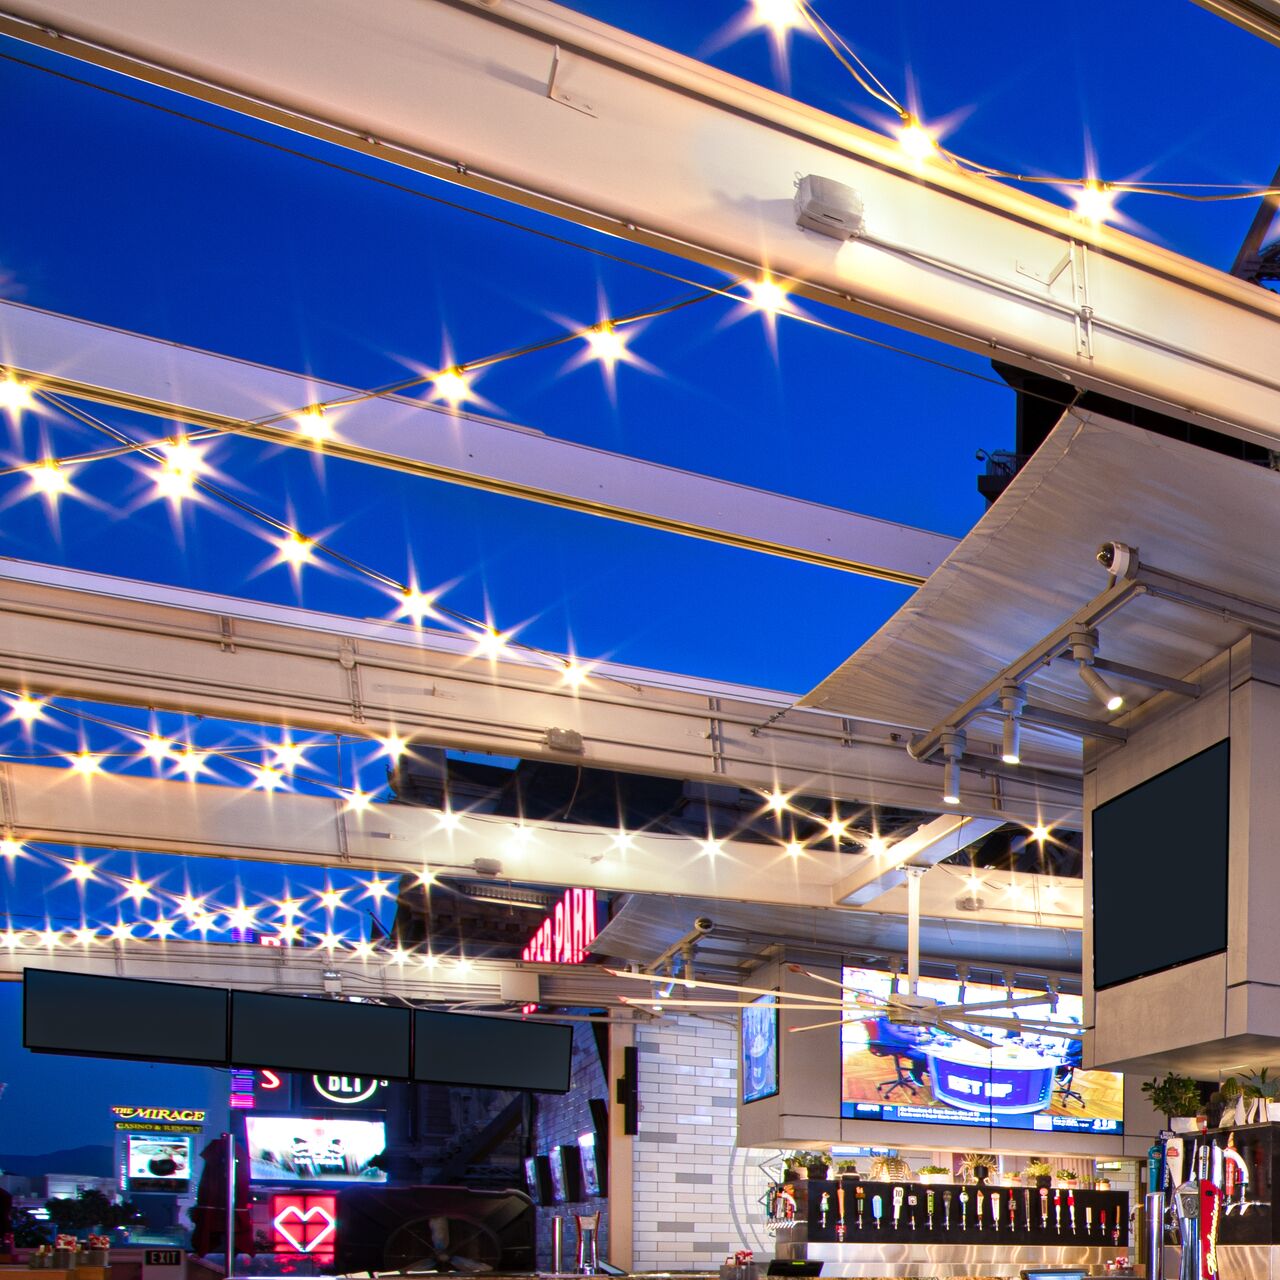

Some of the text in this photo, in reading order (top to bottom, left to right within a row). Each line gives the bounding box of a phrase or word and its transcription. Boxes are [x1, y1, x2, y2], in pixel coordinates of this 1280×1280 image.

[131, 1108, 206, 1121] MIRAGE
[115, 1122, 153, 1131] CASINO
[151, 1251, 178, 1264] EXIT
